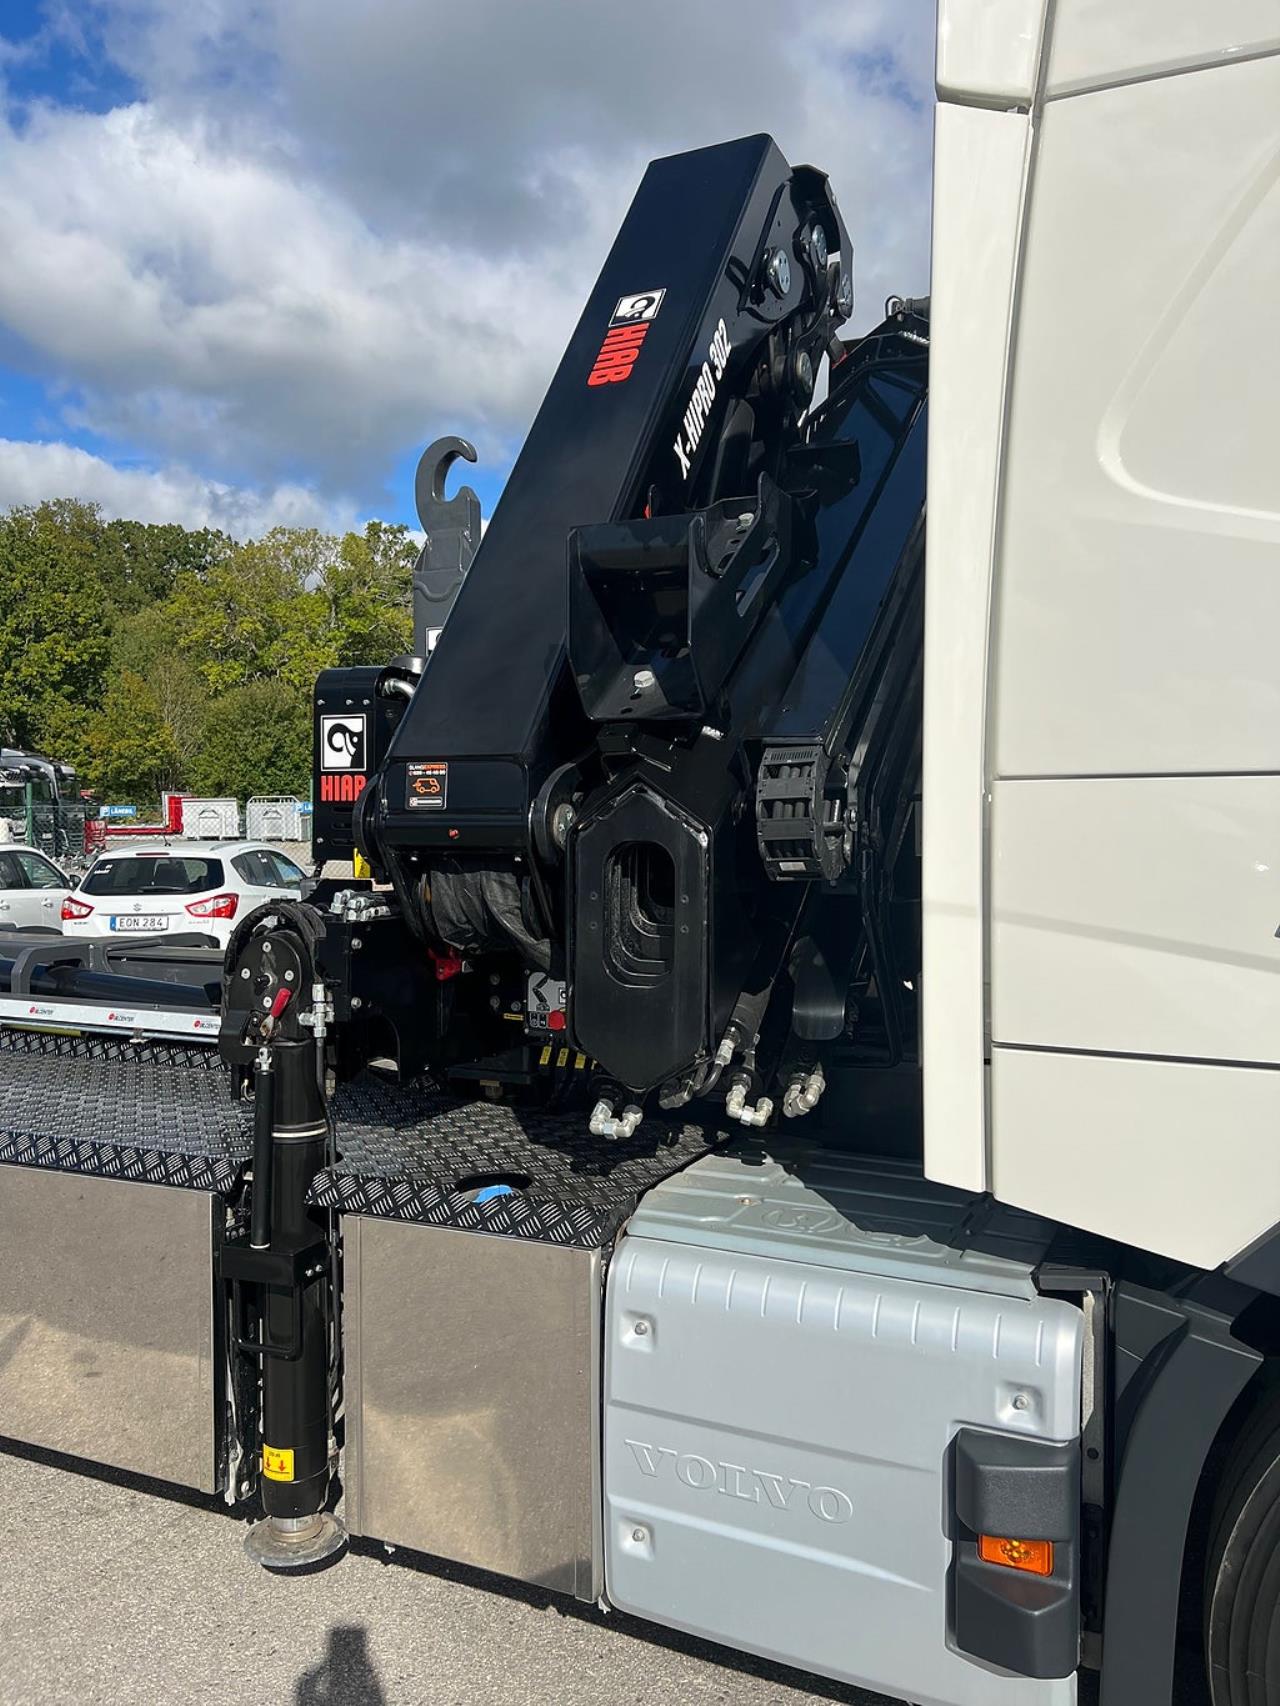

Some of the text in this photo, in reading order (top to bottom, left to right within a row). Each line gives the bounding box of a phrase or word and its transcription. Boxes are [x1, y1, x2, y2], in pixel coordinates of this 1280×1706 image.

[587, 322, 650, 386] HIAB
[673, 318, 732, 480] X-HIPRO 302
[119, 915, 163, 927] EON 284
[624, 1439, 853, 1524] VOLVO
